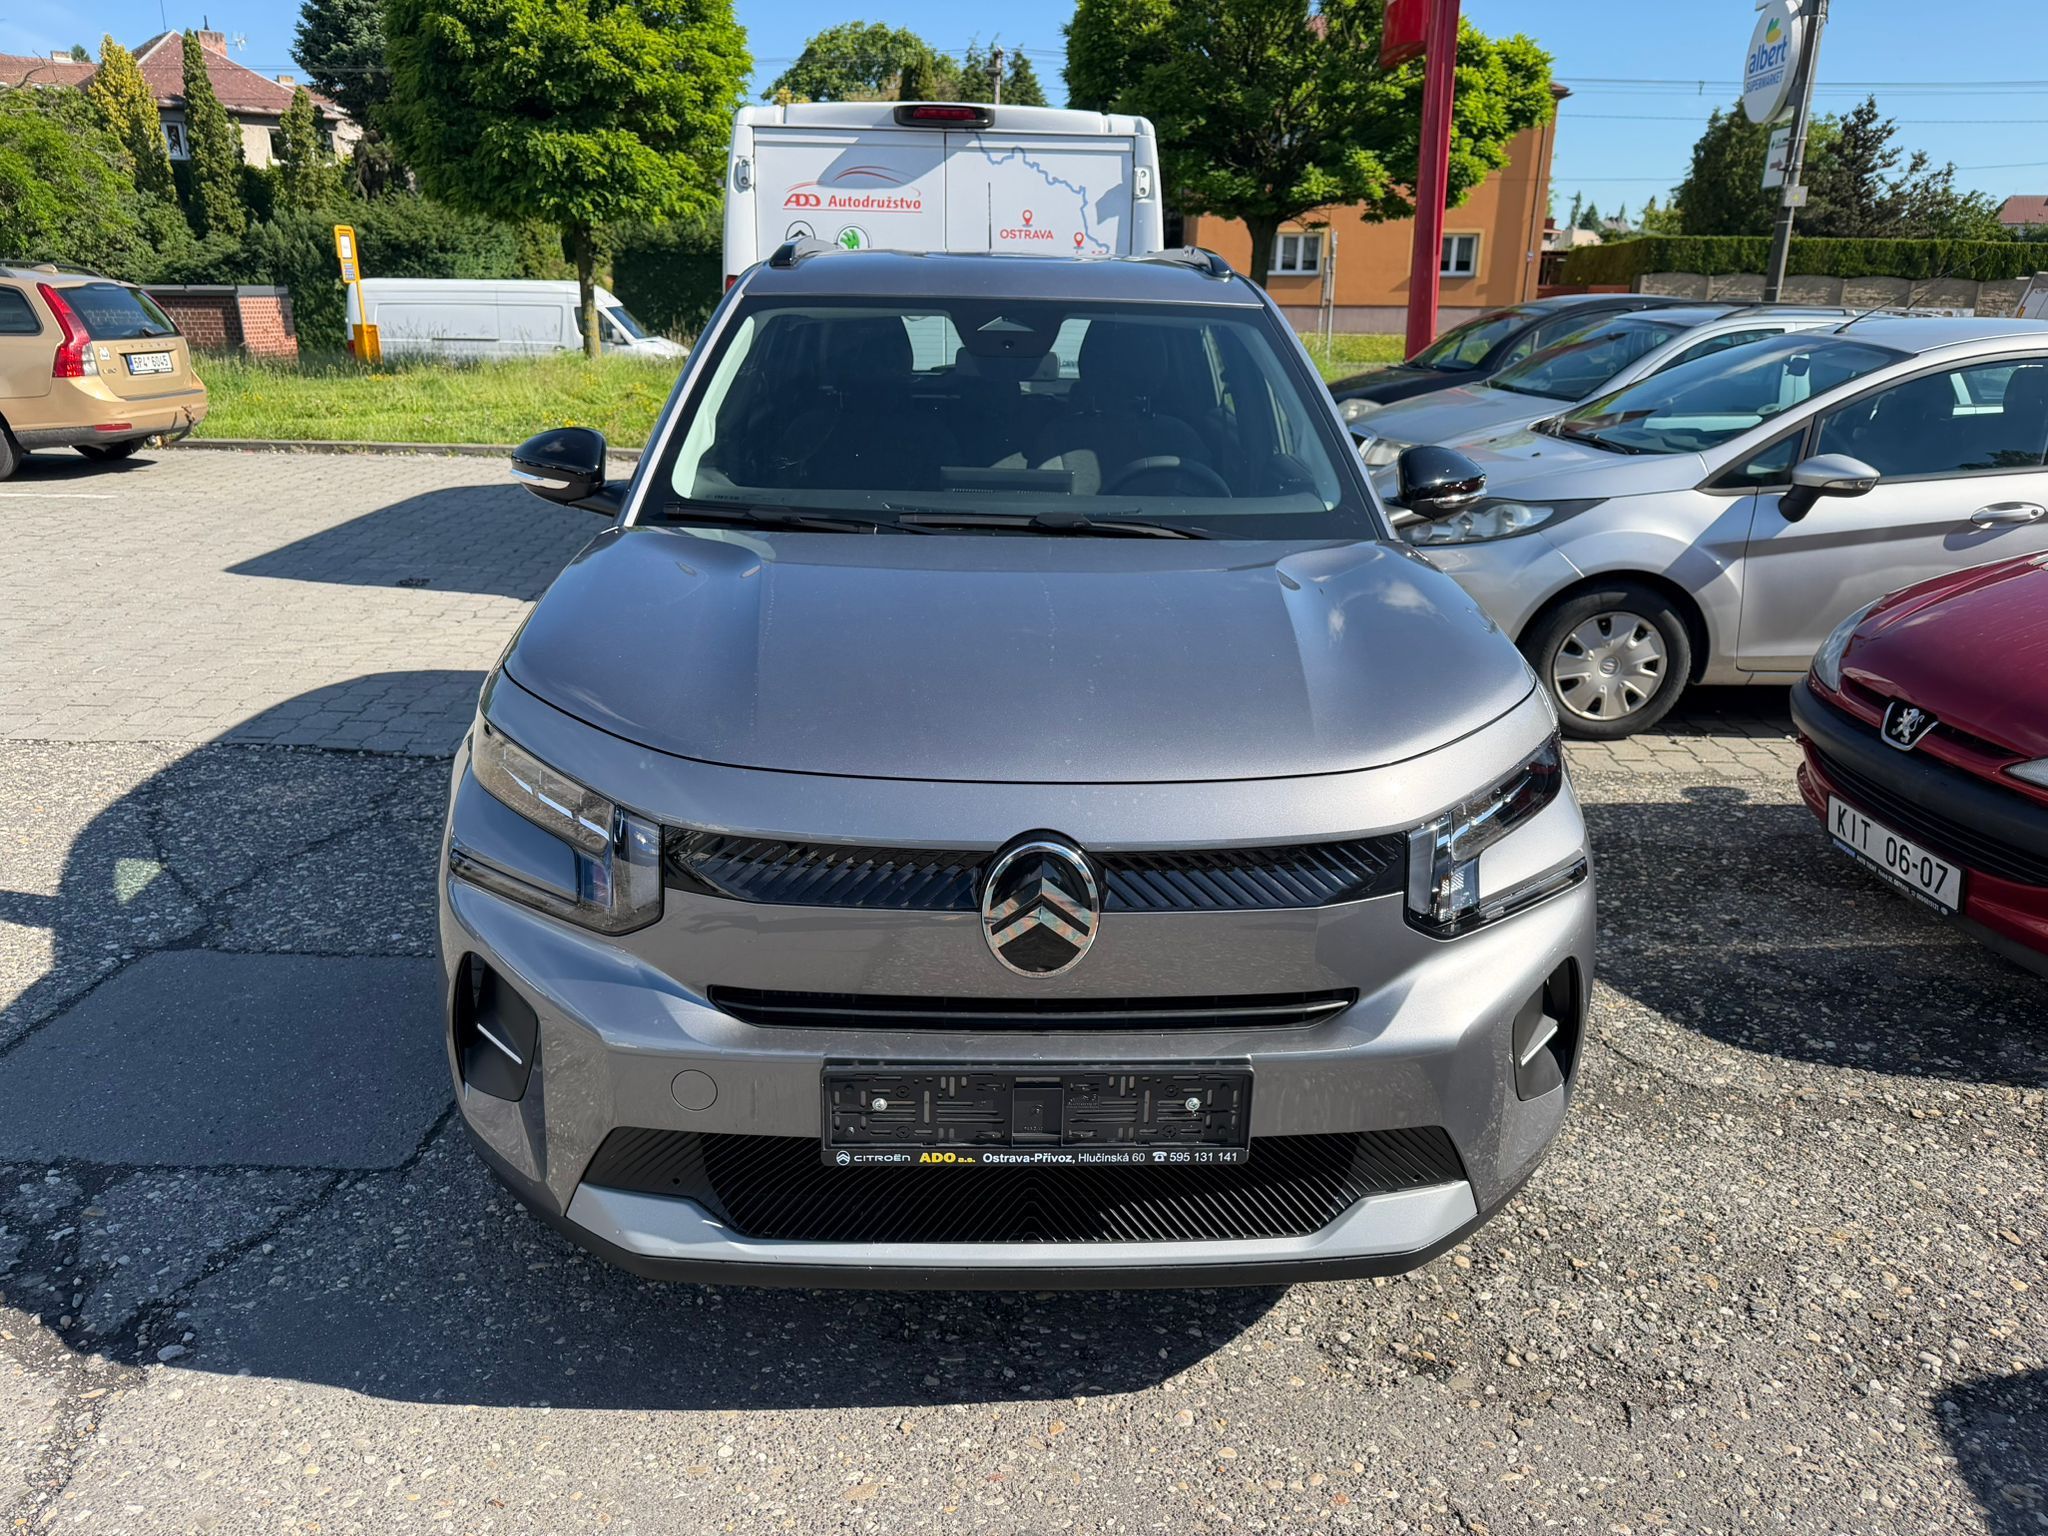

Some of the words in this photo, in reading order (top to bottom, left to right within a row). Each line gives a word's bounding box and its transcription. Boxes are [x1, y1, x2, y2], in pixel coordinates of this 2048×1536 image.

[1748, 35, 1787, 74] albert
[1745, 70, 1784, 93] SUPERMARKET
[783, 192, 821, 207] ADO
[827, 195, 922, 209] Autodružstvo
[999, 228, 1054, 240] OSTRAVA
[1837, 804, 1871, 849] KIT
[1886, 837, 1948, 894] 06-07
[919, 1152, 956, 1163] ADO
[982, 1151, 1076, 1164] Ostrava-Přívoz,
[1078, 1151, 1129, 1163] Hlučínská
[1131, 1153, 1146, 1163] 60
[1169, 1152, 1191, 1162] 595
[1194, 1152, 1214, 1162] 131
[1217, 1152, 1238, 1162] 141
